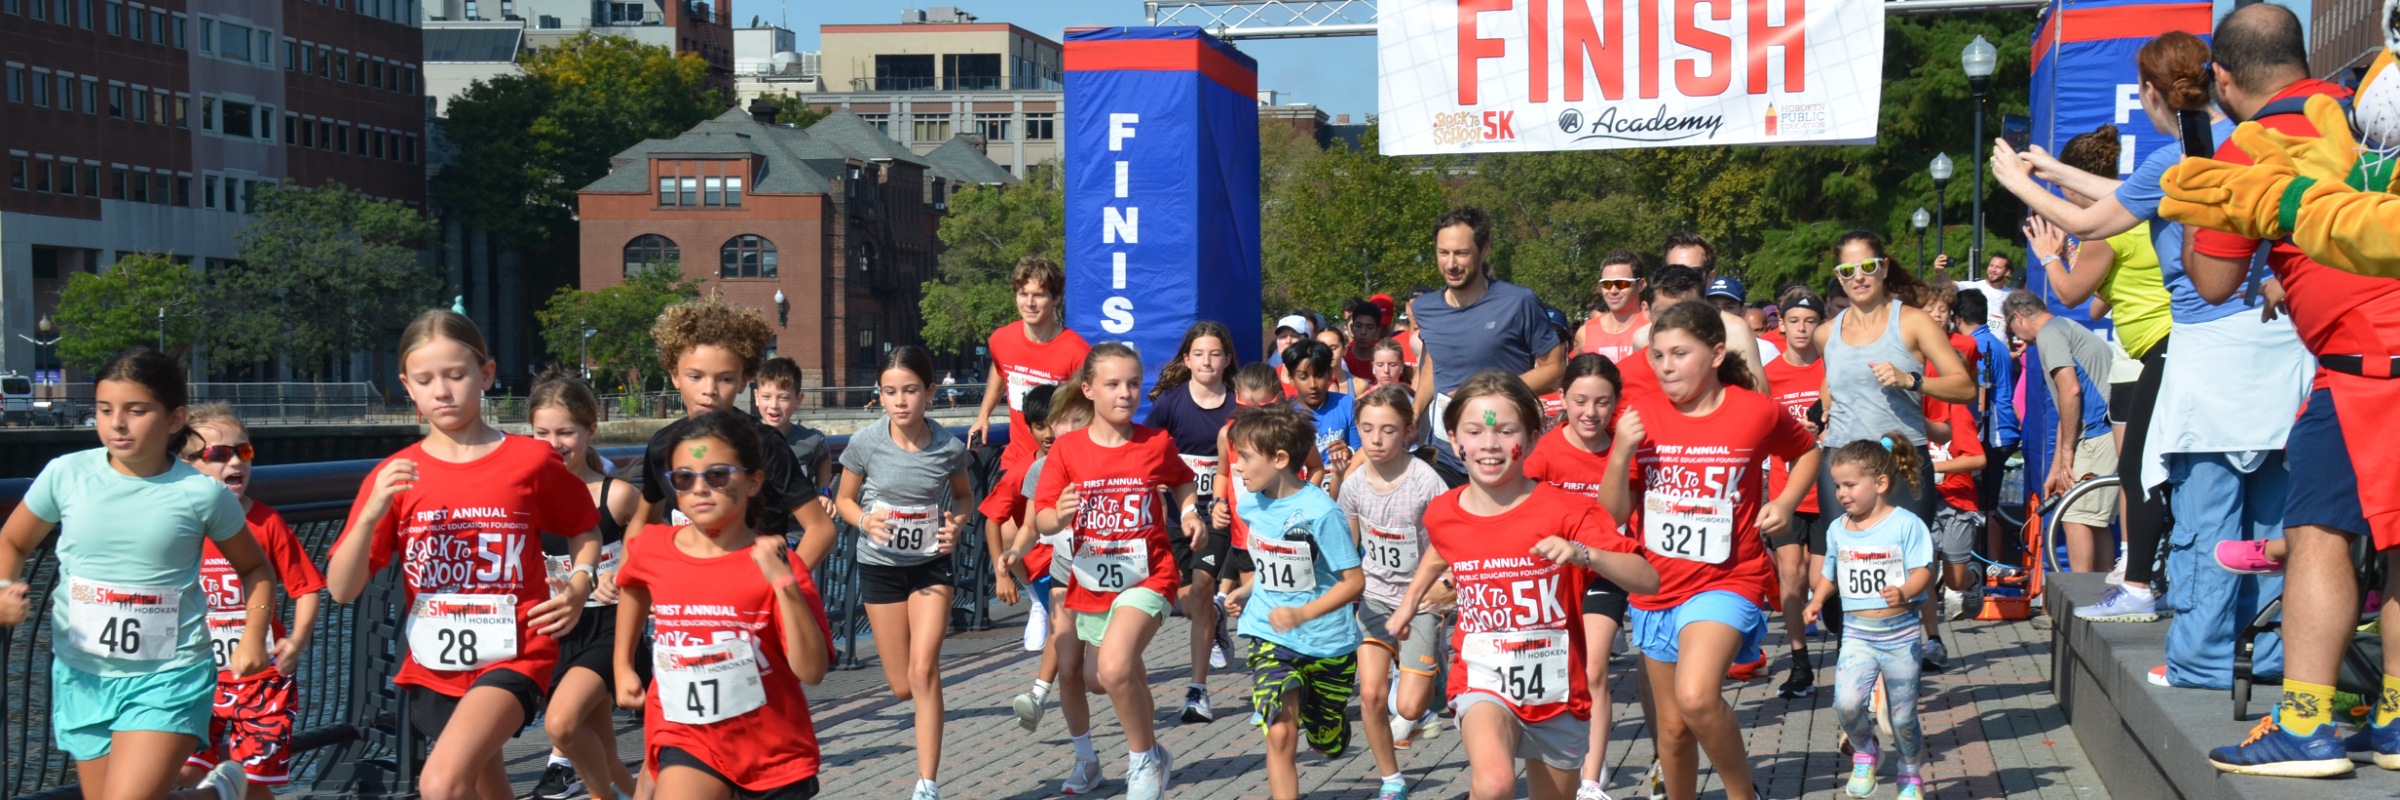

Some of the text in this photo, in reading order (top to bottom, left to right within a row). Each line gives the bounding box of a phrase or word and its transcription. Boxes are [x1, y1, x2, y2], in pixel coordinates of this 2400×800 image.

[1457, 0, 1805, 104] FINISH
[1781, 104, 1825, 112] HOBOKEN
[1483, 110, 1515, 140] 5K
[1592, 103, 1723, 139] Academy
[1781, 112, 1825, 123] PUBLIC
[1100, 113, 1139, 350] FINIS
[1014, 365, 1052, 379] FIRST ANNUAL
[1655, 445, 1730, 455] FIRST ANNUAL
[1083, 478, 1143, 489] FIRST ANNUAL
[1563, 481, 1585, 490] FIRST
[1704, 466, 1746, 503] 5K
[417, 507, 508, 522] FIRST ANNUAL
[1123, 493, 1153, 528] 5K
[1665, 500, 1679, 514] 5K
[422, 524, 446, 532] PUBLIC
[447, 522, 490, 530] EDUCATION
[1662, 522, 1707, 556] 321
[476, 533, 526, 582] 5K
[1368, 540, 1401, 568] 313
[1256, 558, 1295, 588] 314
[1453, 557, 1534, 572] FIRST ANNUAL
[403, 560, 476, 588] SCHOOL
[1097, 563, 1124, 588] 25
[1480, 571, 1519, 580] EDUCATION
[1849, 568, 1887, 594] 568
[96, 587, 114, 604] 5K
[1511, 574, 1566, 626] 5K
[134, 606, 177, 614] HOBOKEN
[429, 600, 447, 616] 5K
[683, 604, 738, 617] ANNUAL
[469, 617, 514, 625] HOBOKEN
[99, 616, 141, 654] 46
[438, 628, 478, 666] 28
[1492, 638, 1508, 654] 5K
[1527, 649, 1567, 659] HOBOKEN
[669, 653, 687, 670] 5K
[708, 657, 754, 674] HOBOKEN
[1493, 663, 1545, 701] 154
[687, 678, 719, 717] 47
